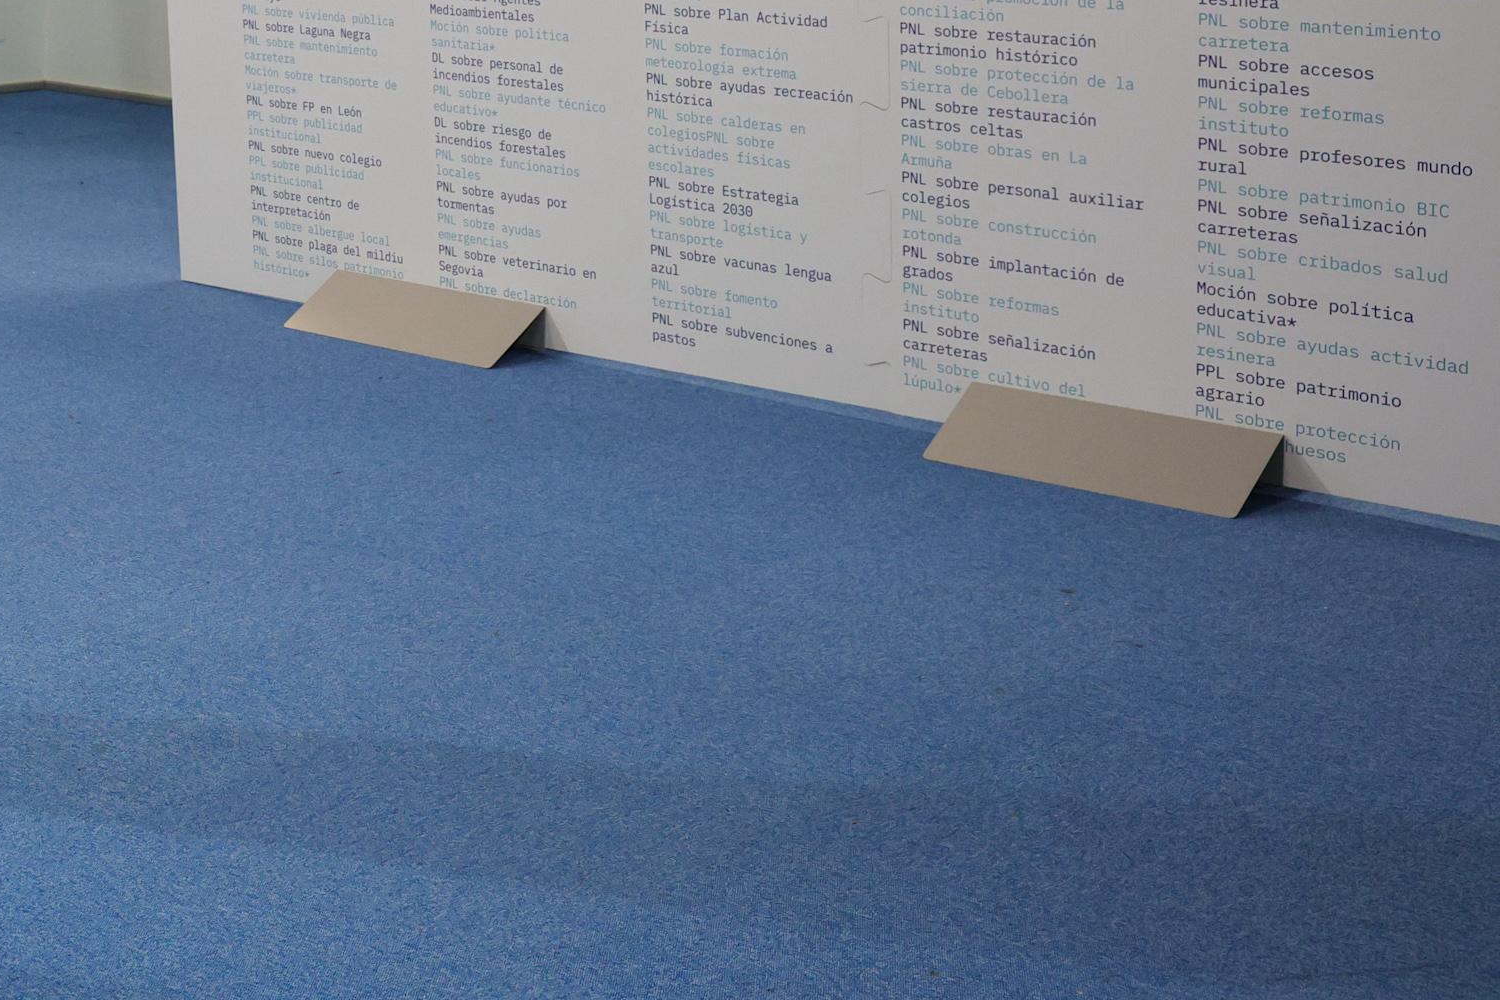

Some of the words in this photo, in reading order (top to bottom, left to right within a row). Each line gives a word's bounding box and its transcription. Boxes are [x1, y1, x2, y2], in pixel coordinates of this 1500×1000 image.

[429, 3, 535, 23] Medioambientales
[644, 2, 667, 16] PNL
[673, 5, 711, 20] sobre
[718, 7, 749, 22] Plan
[756, 10, 828, 28] Actividad
[644, 20, 689, 35] Física
[899, 21, 925, 36] PNL
[934, 24, 978, 40] sobre
[986, 30, 1097, 49] restauración
[431, 51, 445, 64] DL
[450, 54, 484, 68] sobre
[489, 59, 543, 74] personal
[549, 63, 564, 76] de
[899, 41, 987, 60] patrimonio
[995, 47, 1078, 67] histórico
[1198, 53, 1228, 70] PNL
[1238, 57, 1290, 74] sobre
[1300, 64, 1375, 81] accesos
[432, 70, 491, 85] incendios
[497, 73, 565, 93] forestales
[1197, 76, 1310, 97] municipales
[1197, 136, 1228, 153] PNL
[1238, 142, 1289, 159] sobre
[1299, 149, 1406, 171] profesores
[1417, 161, 1473, 177] mundo
[1197, 160, 1247, 176] rural
[436, 180, 456, 194] PNL
[462, 185, 495, 200] sobre
[500, 191, 541, 206] ayudas
[547, 198, 568, 209] por
[648, 175, 670, 190] PNL
[677, 180, 715, 195] sobre
[722, 184, 799, 207] Estrategia
[901, 170, 927, 186] PNL
[936, 175, 979, 192] sobre
[988, 183, 1060, 201] personal
[1068, 192, 1145, 211] auxiliar
[901, 190, 971, 210] colegios
[437, 196, 495, 215] tormentas
[649, 192, 716, 213] Logística
[722, 202, 754, 218] 2030
[1197, 198, 1227, 215] PNL
[1237, 204, 1288, 222] sobre
[1299, 212, 1427, 238] señalización
[252, 229, 270, 242] PNL
[274, 234, 303, 248] sobre
[308, 239, 338, 256] plaga
[342, 244, 361, 258] del
[1197, 222, 1298, 244] carreteras
[650, 243, 672, 258] PNL
[679, 249, 717, 265] sobre
[723, 257, 777, 274] vacunas
[784, 263, 833, 283] lengua
[650, 263, 680, 277] azul
[902, 244, 928, 260] PNL
[936, 251, 980, 267] sobre
[988, 255, 1097, 283] implantación
[1105, 272, 1125, 287] de
[902, 265, 954, 282] grados
[1195, 386, 1265, 407] agrario
[1196, 362, 1225, 380] PPL
[1235, 371, 1286, 390] sobre
[1296, 381, 1402, 408] patrimonio
